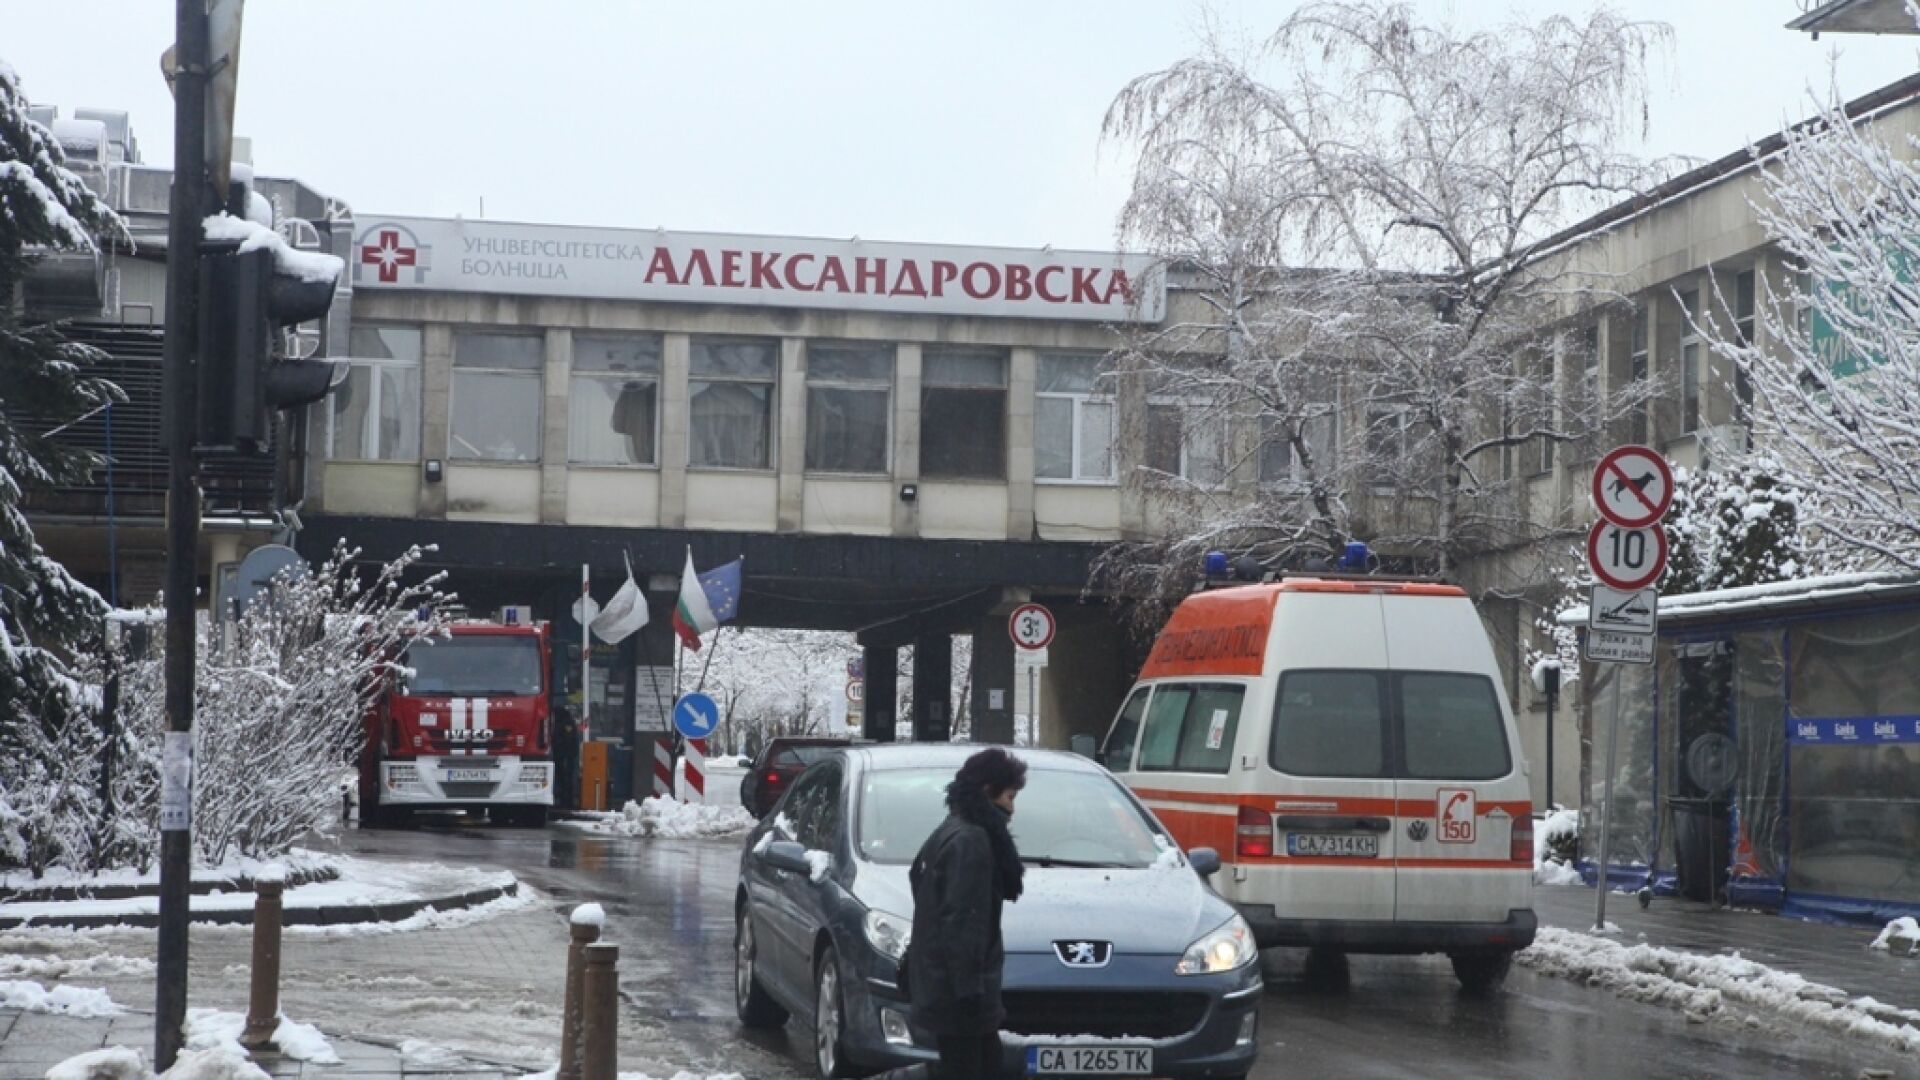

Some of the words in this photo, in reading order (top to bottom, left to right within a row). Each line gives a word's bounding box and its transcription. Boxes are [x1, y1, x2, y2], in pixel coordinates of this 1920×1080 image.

[462, 236, 644, 261] УНИВЕРСИТЕТСКА
[461, 258, 569, 280] БОЛНИЦА
[643, 246, 1133, 306] АЛЕКСАНДРОВСКА
[1609, 529, 1645, 569] 10
[443, 728, 494, 740] IVECO
[1442, 821, 1472, 840] 150
[1040, 1050, 1066, 1070] CA
[1073, 1051, 1118, 1070] 1265
[1123, 1051, 1148, 1070] TK
